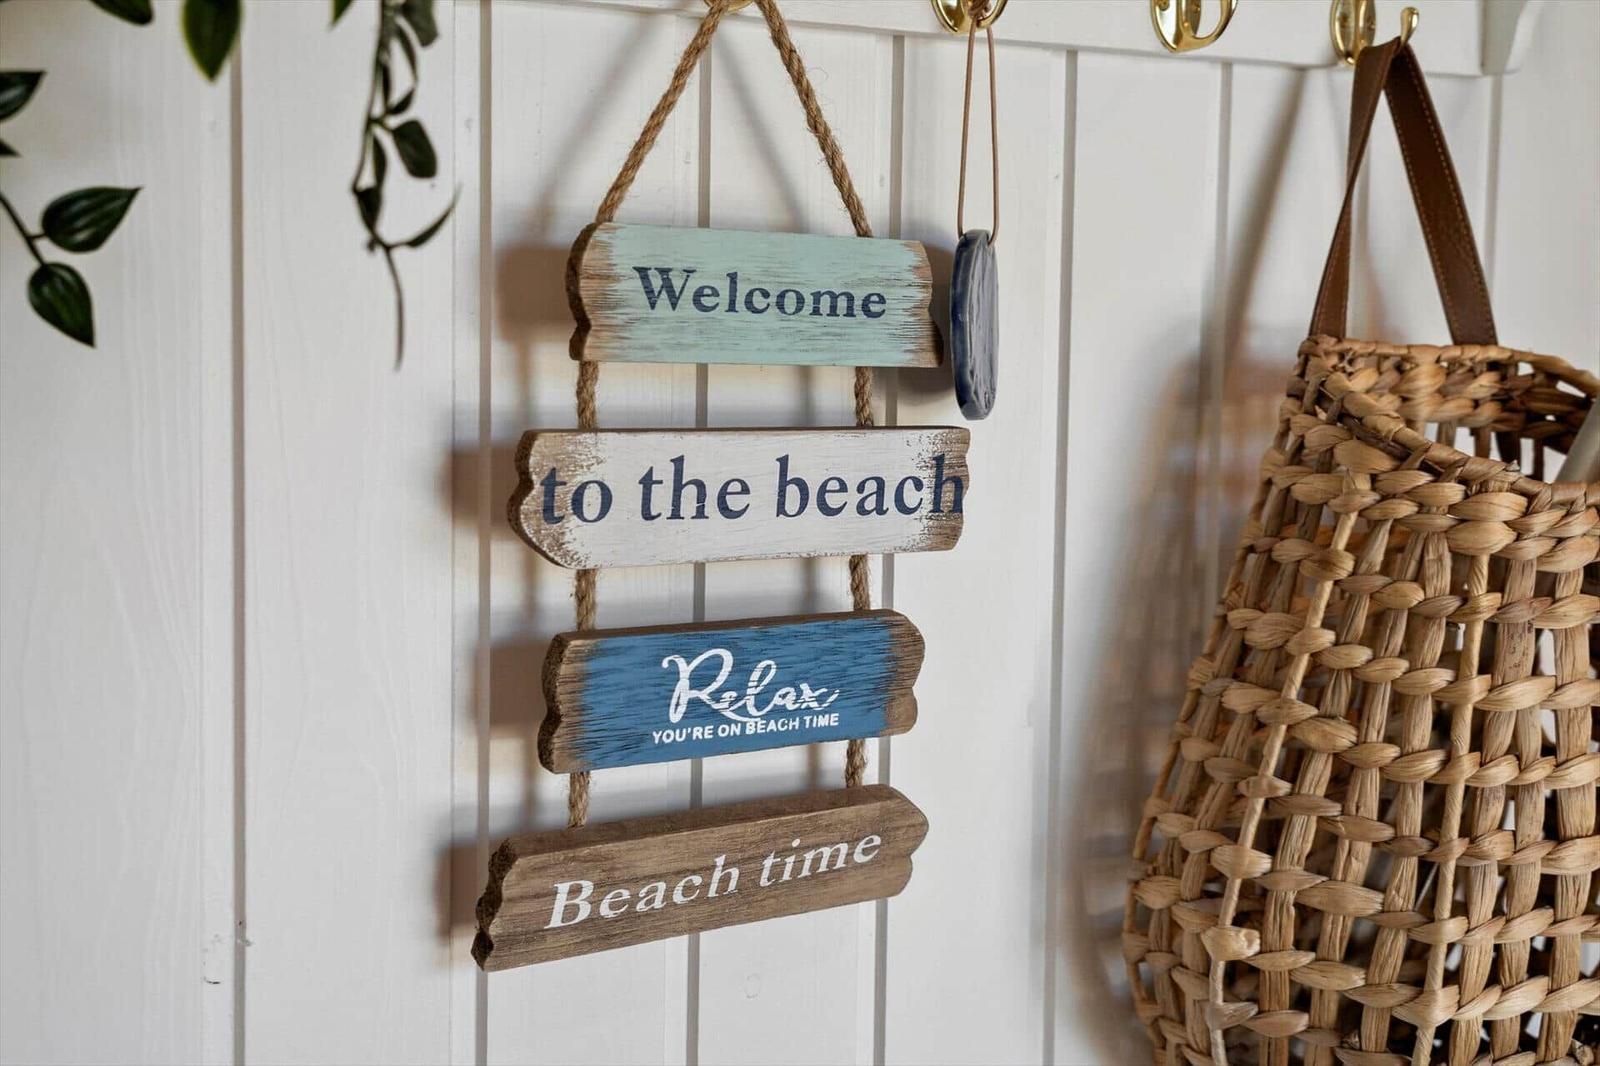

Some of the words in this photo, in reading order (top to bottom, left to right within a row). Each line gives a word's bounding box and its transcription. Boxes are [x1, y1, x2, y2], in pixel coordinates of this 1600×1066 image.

[633, 266, 887, 319] Welcome
[540, 466, 613, 525] to
[639, 455, 751, 521] the
[775, 453, 965, 518] beach
[662, 648, 840, 724] Relax
[652, 725, 714, 744] YOU'RE
[718, 723, 741, 737] ON
[746, 717, 800, 735] BEACH
[803, 713, 840, 728] TIME
[544, 854, 740, 929] Beach
[759, 834, 882, 887] time
